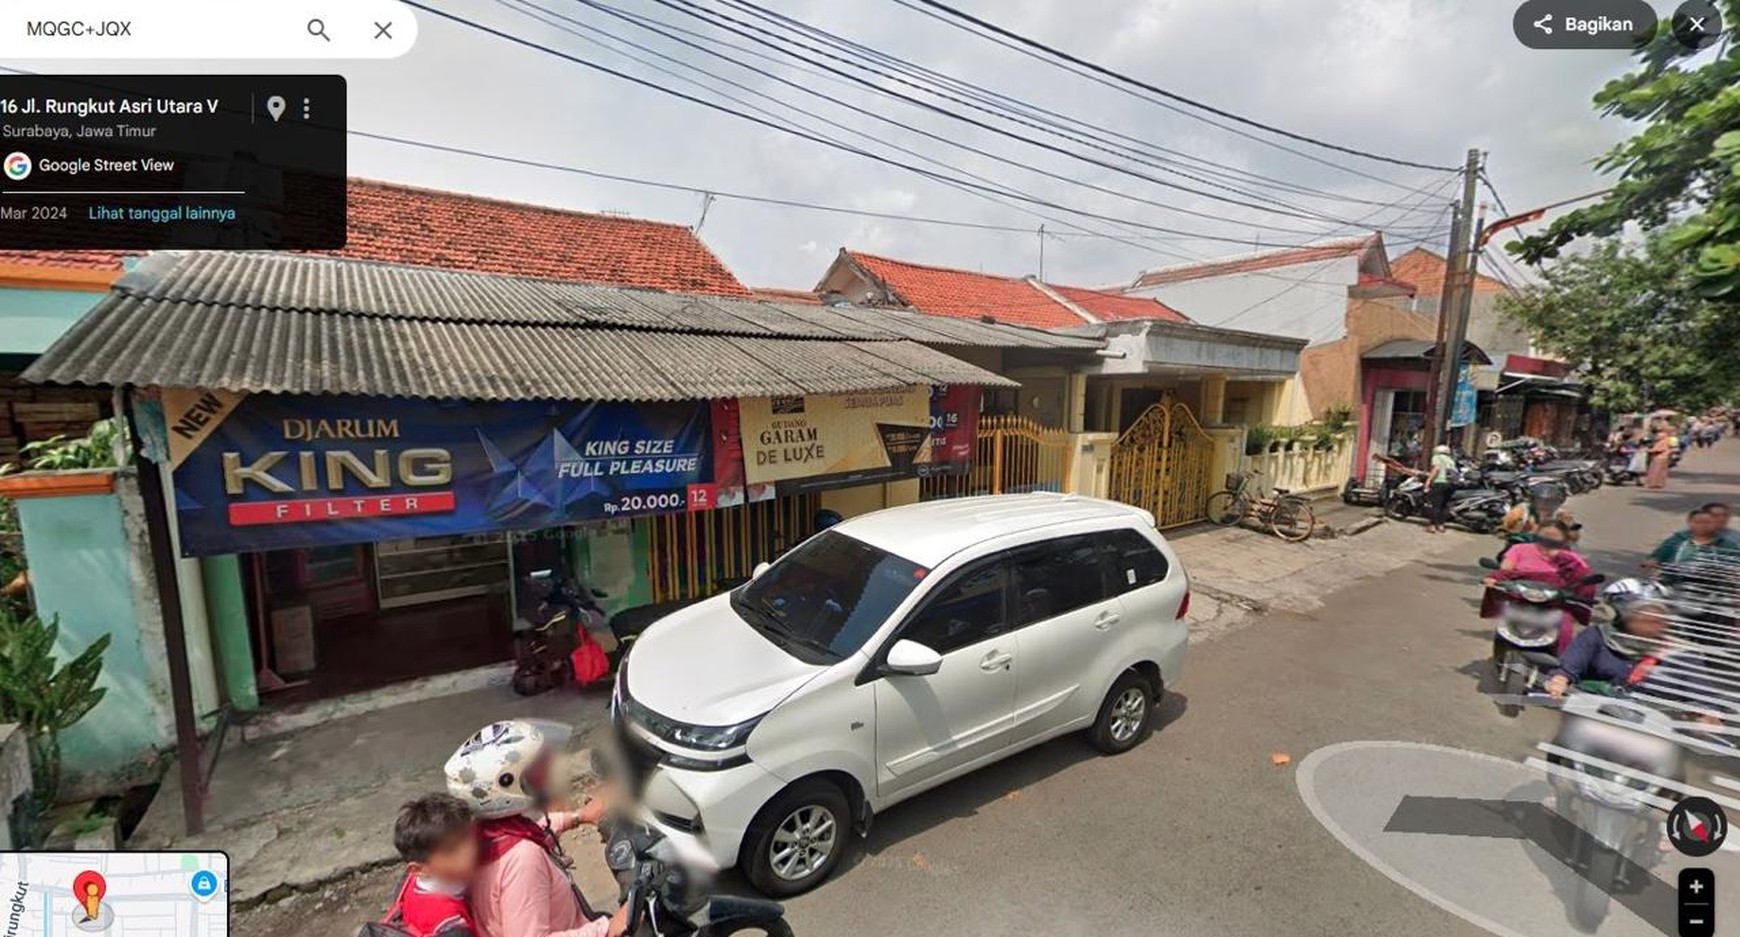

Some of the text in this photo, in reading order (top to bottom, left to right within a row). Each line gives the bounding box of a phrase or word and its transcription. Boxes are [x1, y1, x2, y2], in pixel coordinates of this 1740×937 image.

[172, 393, 224, 439] NEW
[282, 418, 401, 441] DJARUM
[760, 427, 818, 446] GARAM
[585, 439, 675, 456] KING SIZE
[757, 443, 824, 466] DE LUXE
[222, 448, 453, 495] KING
[558, 458, 698, 479] FULL PLEASURE
[691, 489, 708, 503] 12
[276, 498, 419, 518] FILTER
